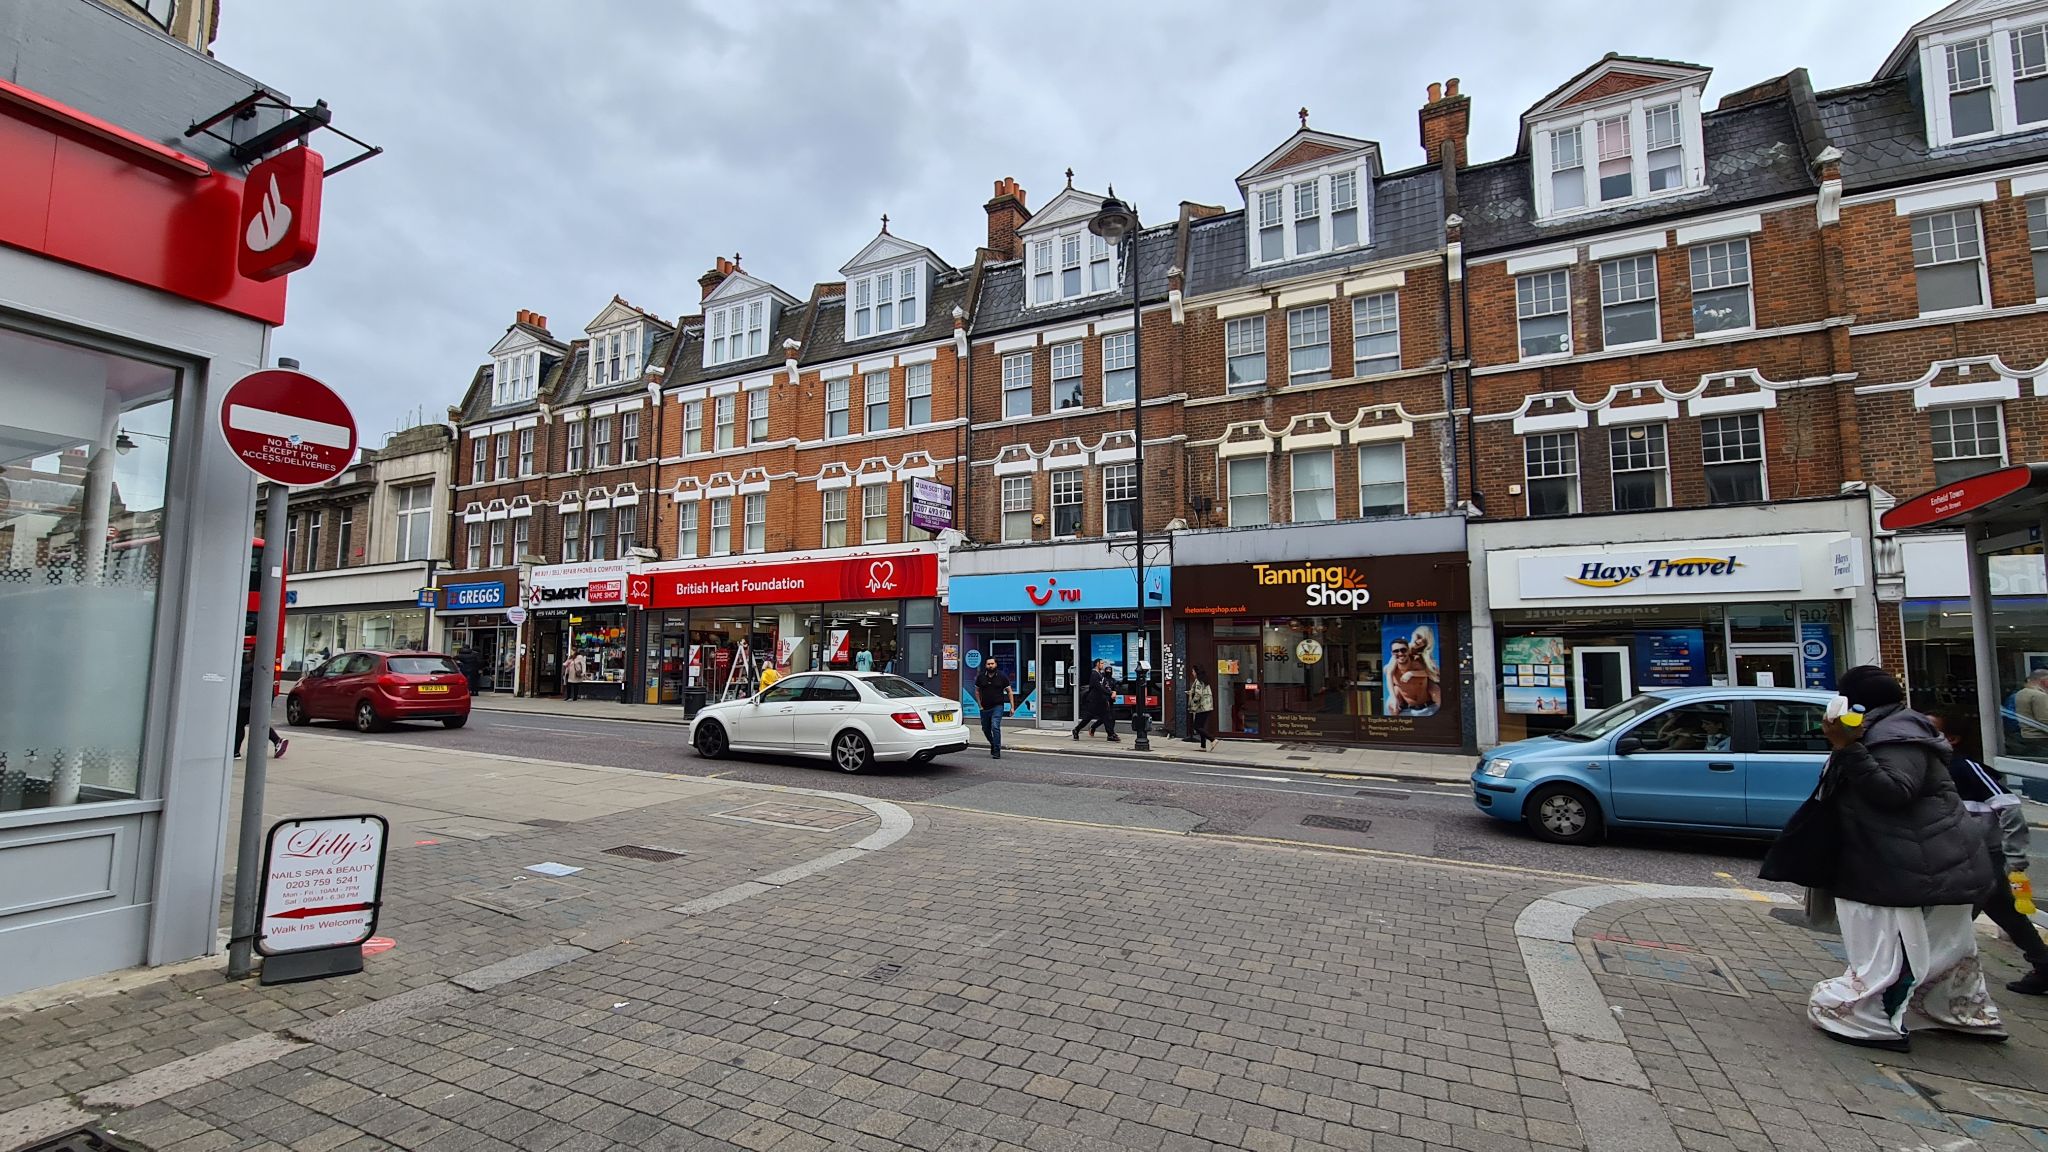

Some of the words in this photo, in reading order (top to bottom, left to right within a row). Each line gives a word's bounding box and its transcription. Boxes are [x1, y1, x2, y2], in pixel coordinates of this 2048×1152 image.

[267, 438, 282, 447] NO
[285, 440, 315, 452] ENTRY
[262, 445, 298, 457] EXCEPT
[300, 452, 319, 461] FOR
[242, 449, 337, 472] ACCESS/DELIVERIES
[1930, 492, 1948, 506] Enfield
[1949, 489, 1965, 499] Town
[1834, 553, 1849, 565] Hays
[577, 566, 593, 574] PHONES
[598, 565, 623, 573] COMPUTERS
[1252, 562, 1342, 589] Tanning
[1579, 562, 1642, 583] Hays
[1648, 556, 1736, 578] Travel
[1833, 562, 1851, 576] Travel
[589, 583, 607, 591] SHISHA
[608, 581, 620, 589] TIME
[676, 581, 708, 595] British
[711, 580, 739, 594] Heart
[741, 577, 805, 592] Foundation
[459, 588, 500, 604] GREGGS
[589, 592, 602, 600] VAPE
[604, 591, 619, 599] SHOP
[1057, 589, 1081, 602] TUI
[1306, 583, 1370, 611] Shop
[1184, 604, 1247, 615] thetanningshop.co.uk
[1388, 600, 1405, 608] Time
[1416, 599, 1437, 607] Shine
[978, 615, 1000, 623] TRAVEL
[1095, 612, 1120, 620] TRAVEL
[1121, 611, 1139, 619] MON
[1263, 652, 1289, 664] Shop
[279, 828, 375, 866] Lilly's
[271, 870, 302, 880] NAILS
[305, 868, 325, 877] SPA
[326, 867, 333, 875] &
[335, 864, 375, 874] BEAUTY
[286, 880, 310, 889] 0203
[313, 878, 331, 887] 759
[336, 875, 359, 885] 5241
[283, 891, 298, 899] Mon
[320, 887, 339, 895] 10AM
[303, 895, 324, 903] 09AM
[271, 925, 297, 935] Walk
[300, 923, 315, 931] Ins
[319, 918, 364, 929] Welcome
